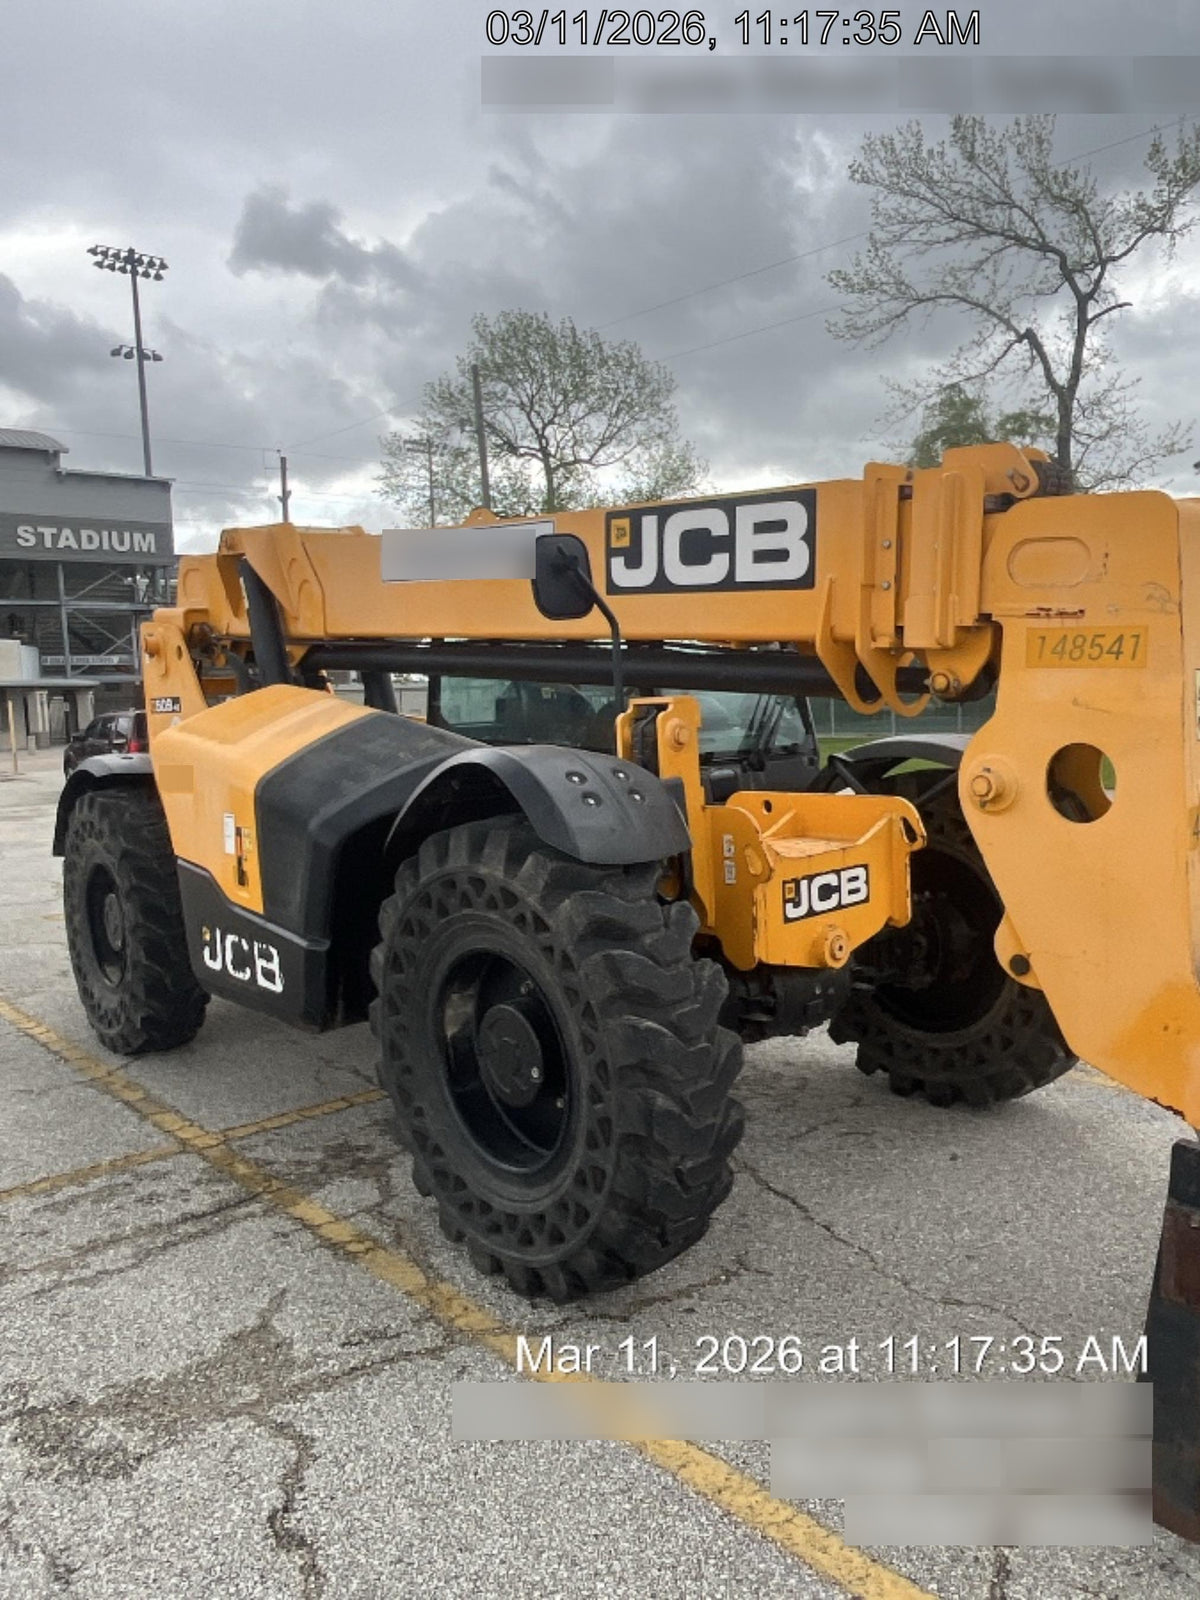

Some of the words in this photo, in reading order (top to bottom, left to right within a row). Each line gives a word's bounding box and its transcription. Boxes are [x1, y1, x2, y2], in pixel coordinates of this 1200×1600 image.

[16, 525, 157, 553] STADIUM
[610, 501, 810, 588] JCB
[1037, 633, 1142, 662] 148541
[784, 866, 868, 919] JCB
[203, 927, 285, 994] JCB
